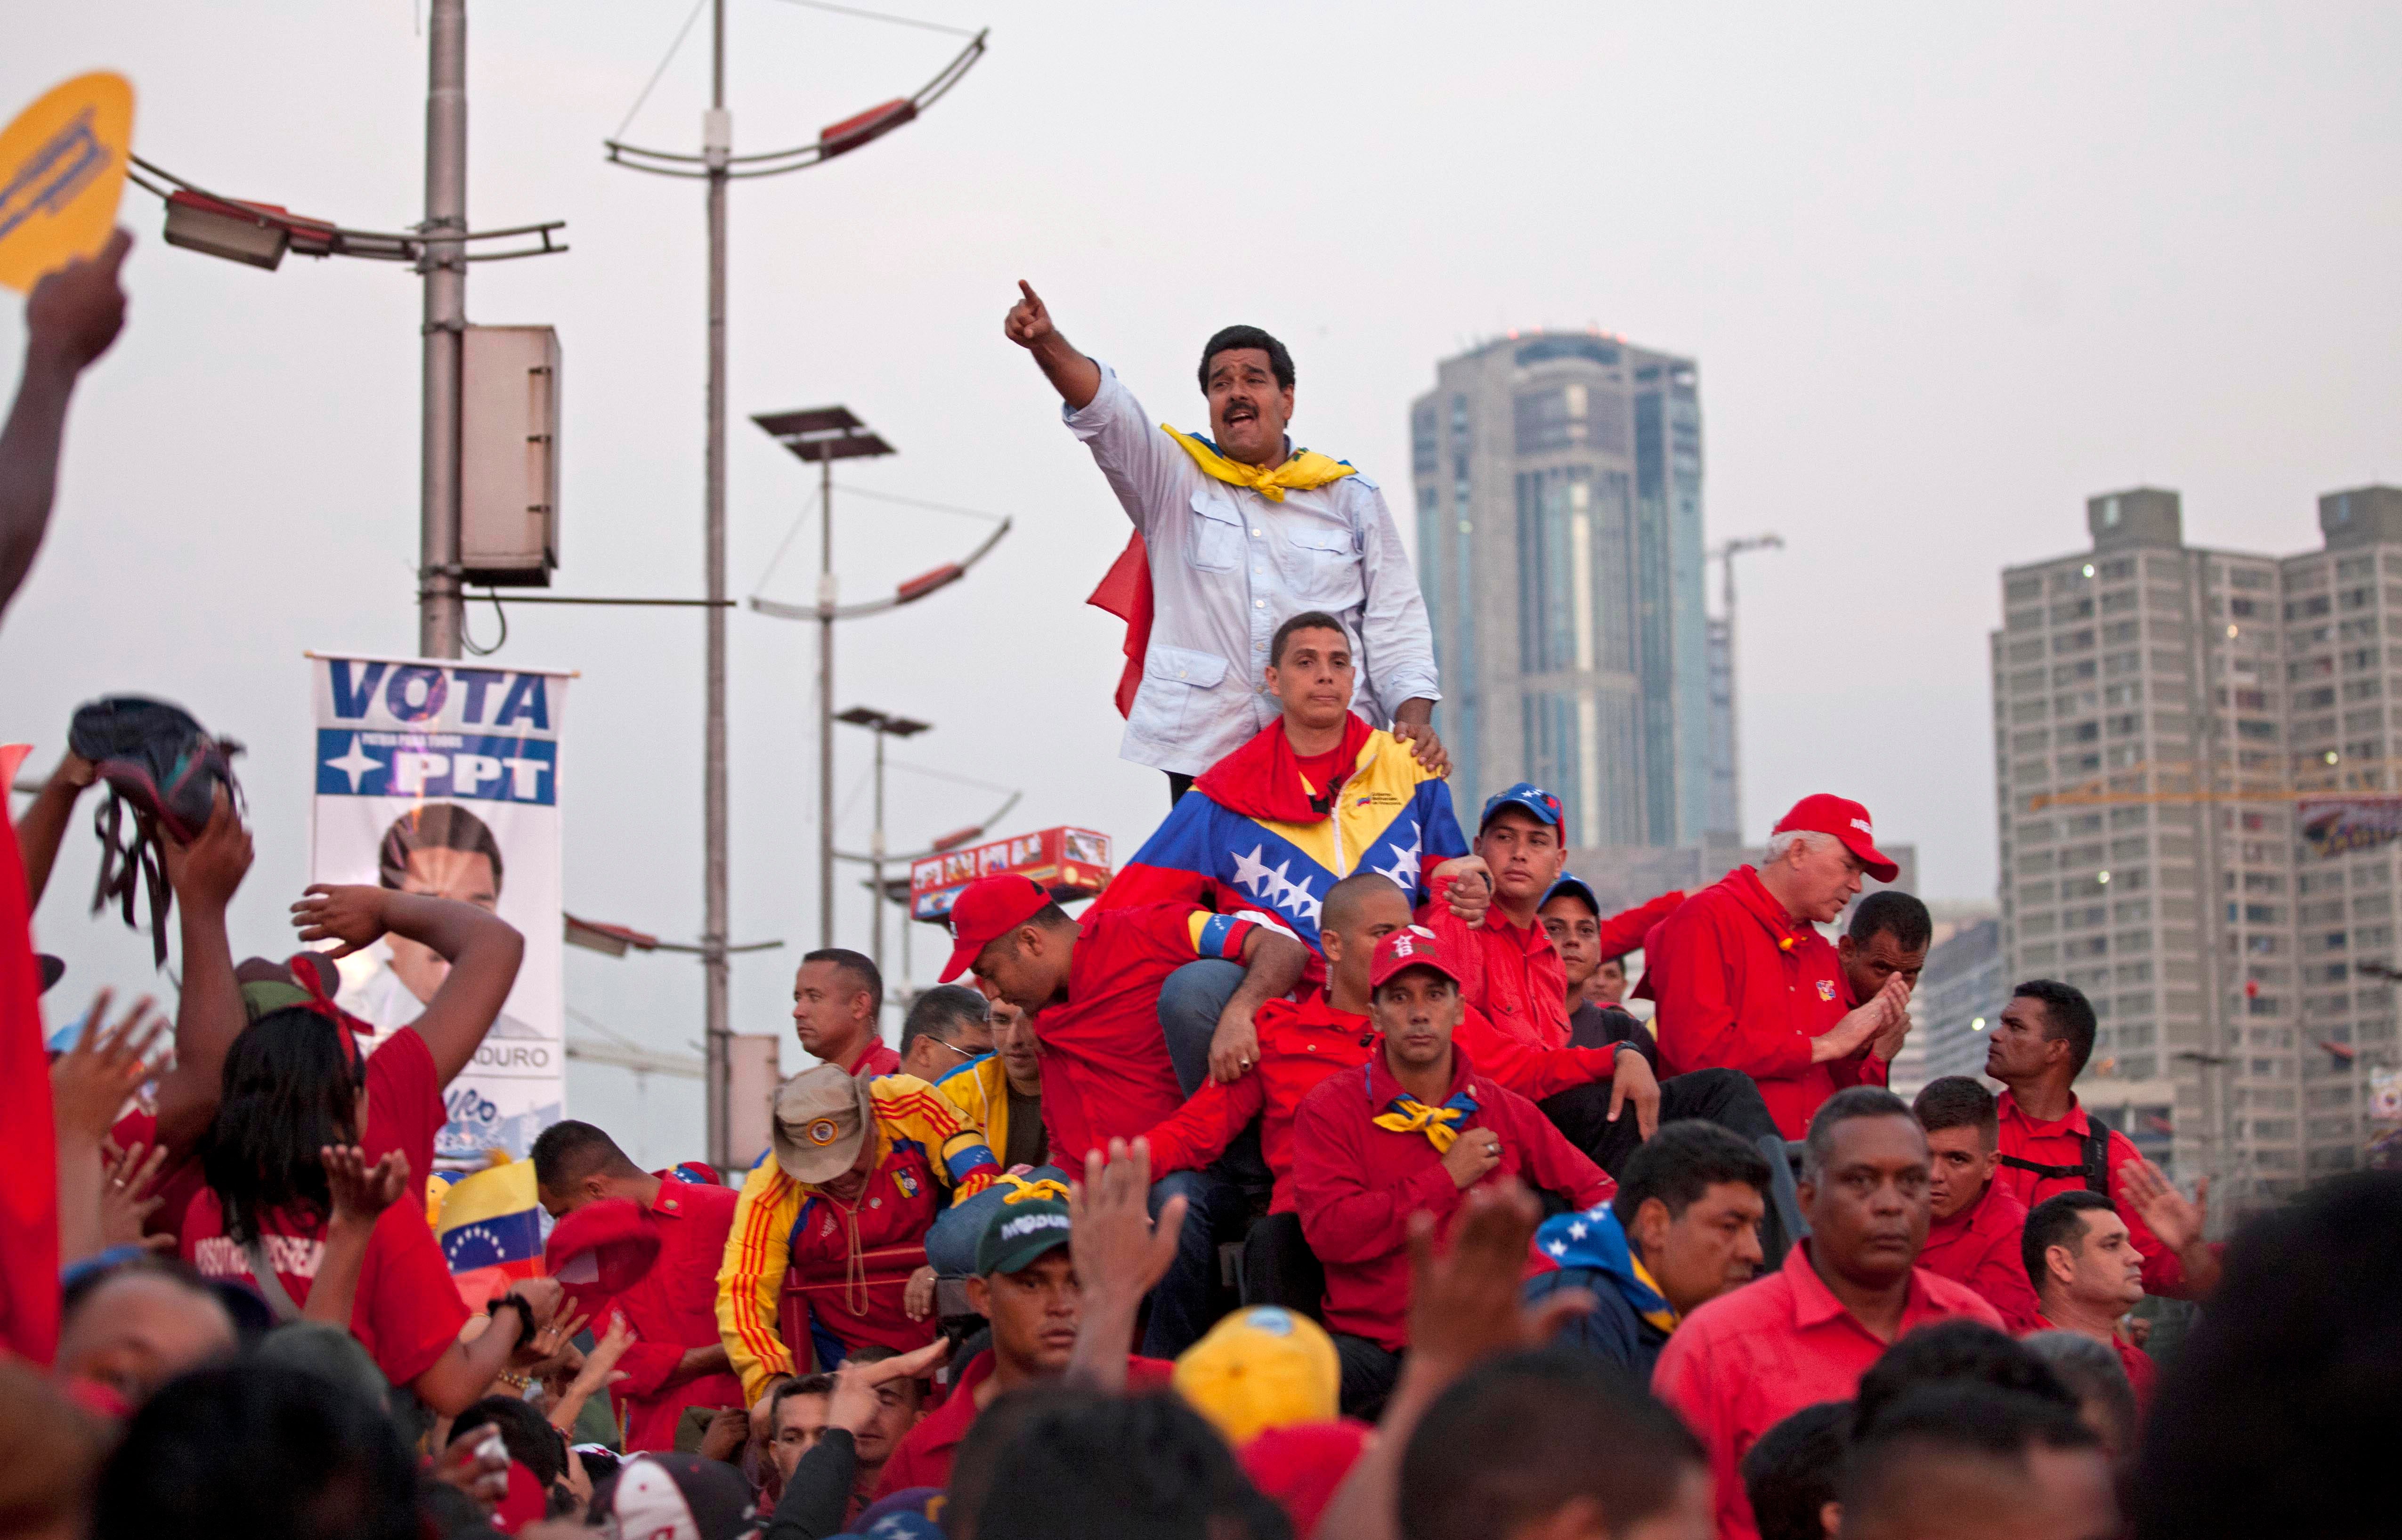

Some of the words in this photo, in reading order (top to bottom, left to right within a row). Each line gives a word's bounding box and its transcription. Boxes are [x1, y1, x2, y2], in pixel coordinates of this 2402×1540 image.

[329, 659, 549, 730] VOTA
[395, 752, 550, 800] PPT
[472, 1046, 550, 1068] DURO
